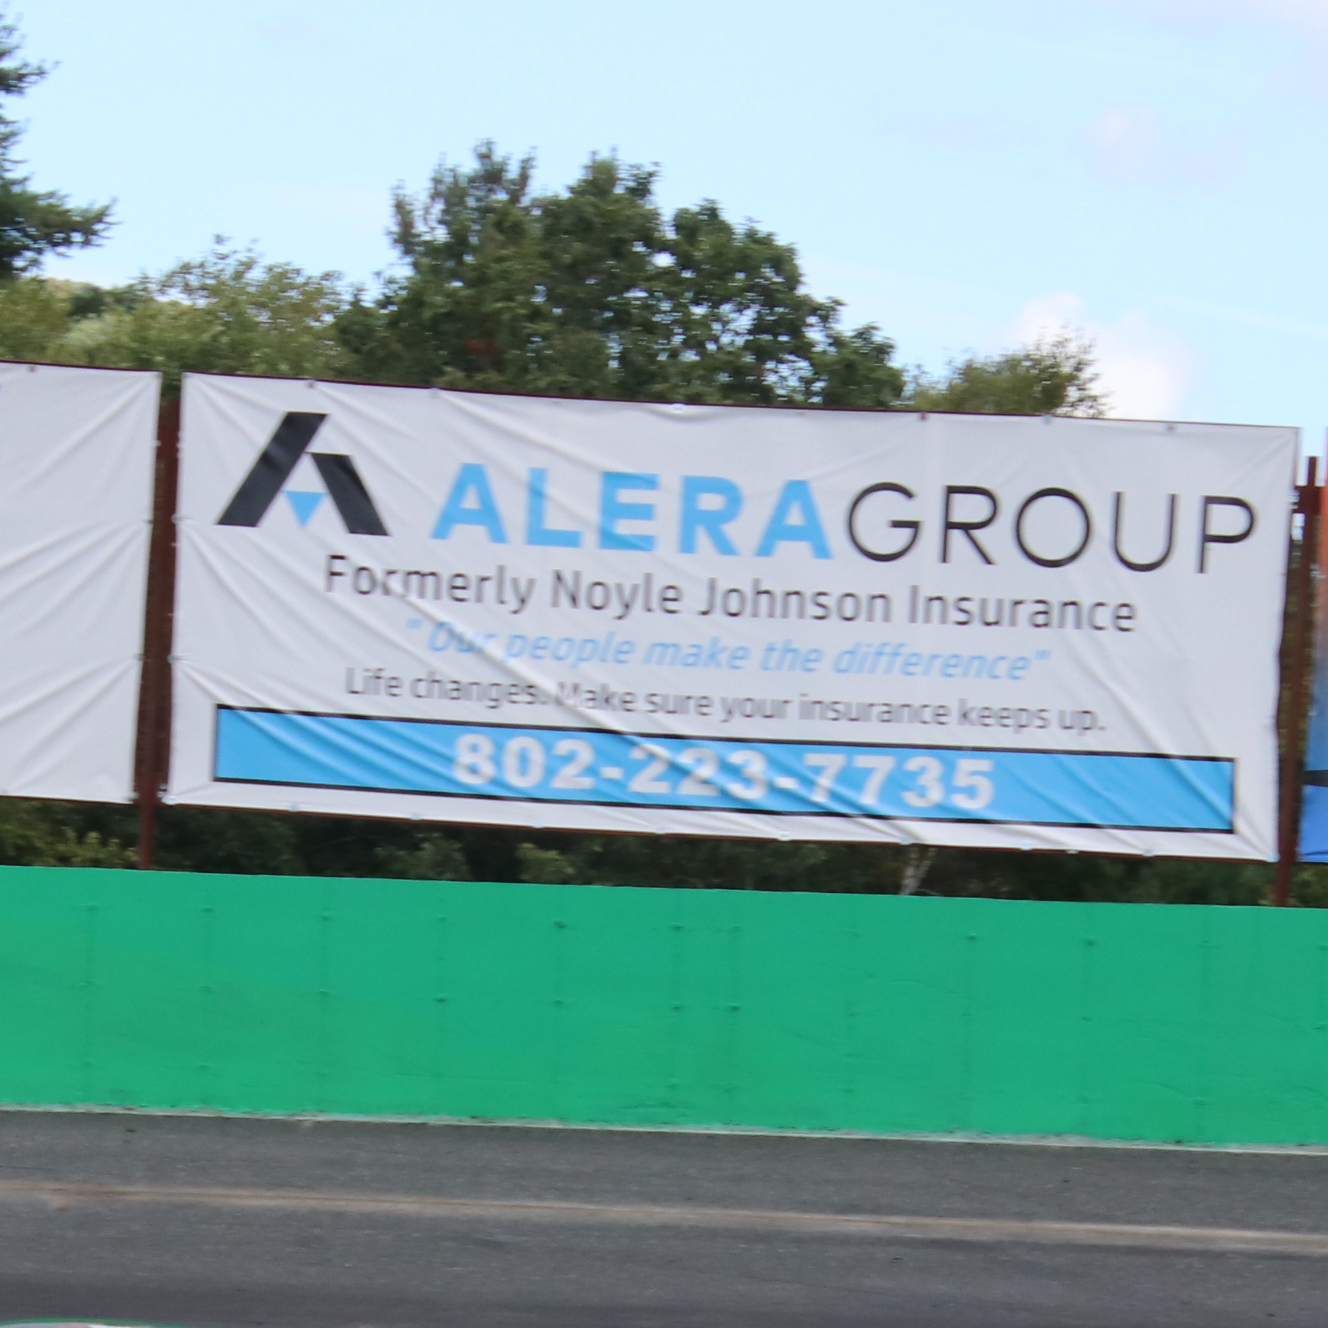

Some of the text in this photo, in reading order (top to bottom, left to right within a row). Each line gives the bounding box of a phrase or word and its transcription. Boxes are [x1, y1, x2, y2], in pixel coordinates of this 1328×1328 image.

[324, 554, 1137, 632] Formerly Noyle Johnson Insurance
[503, 628, 633, 671] people
[639, 636, 753, 671] make
[758, 641, 824, 674] the
[345, 666, 1107, 737] Life changes. Make sure your insurance keeps up.
[452, 733, 996, 810] 802-223-7735
